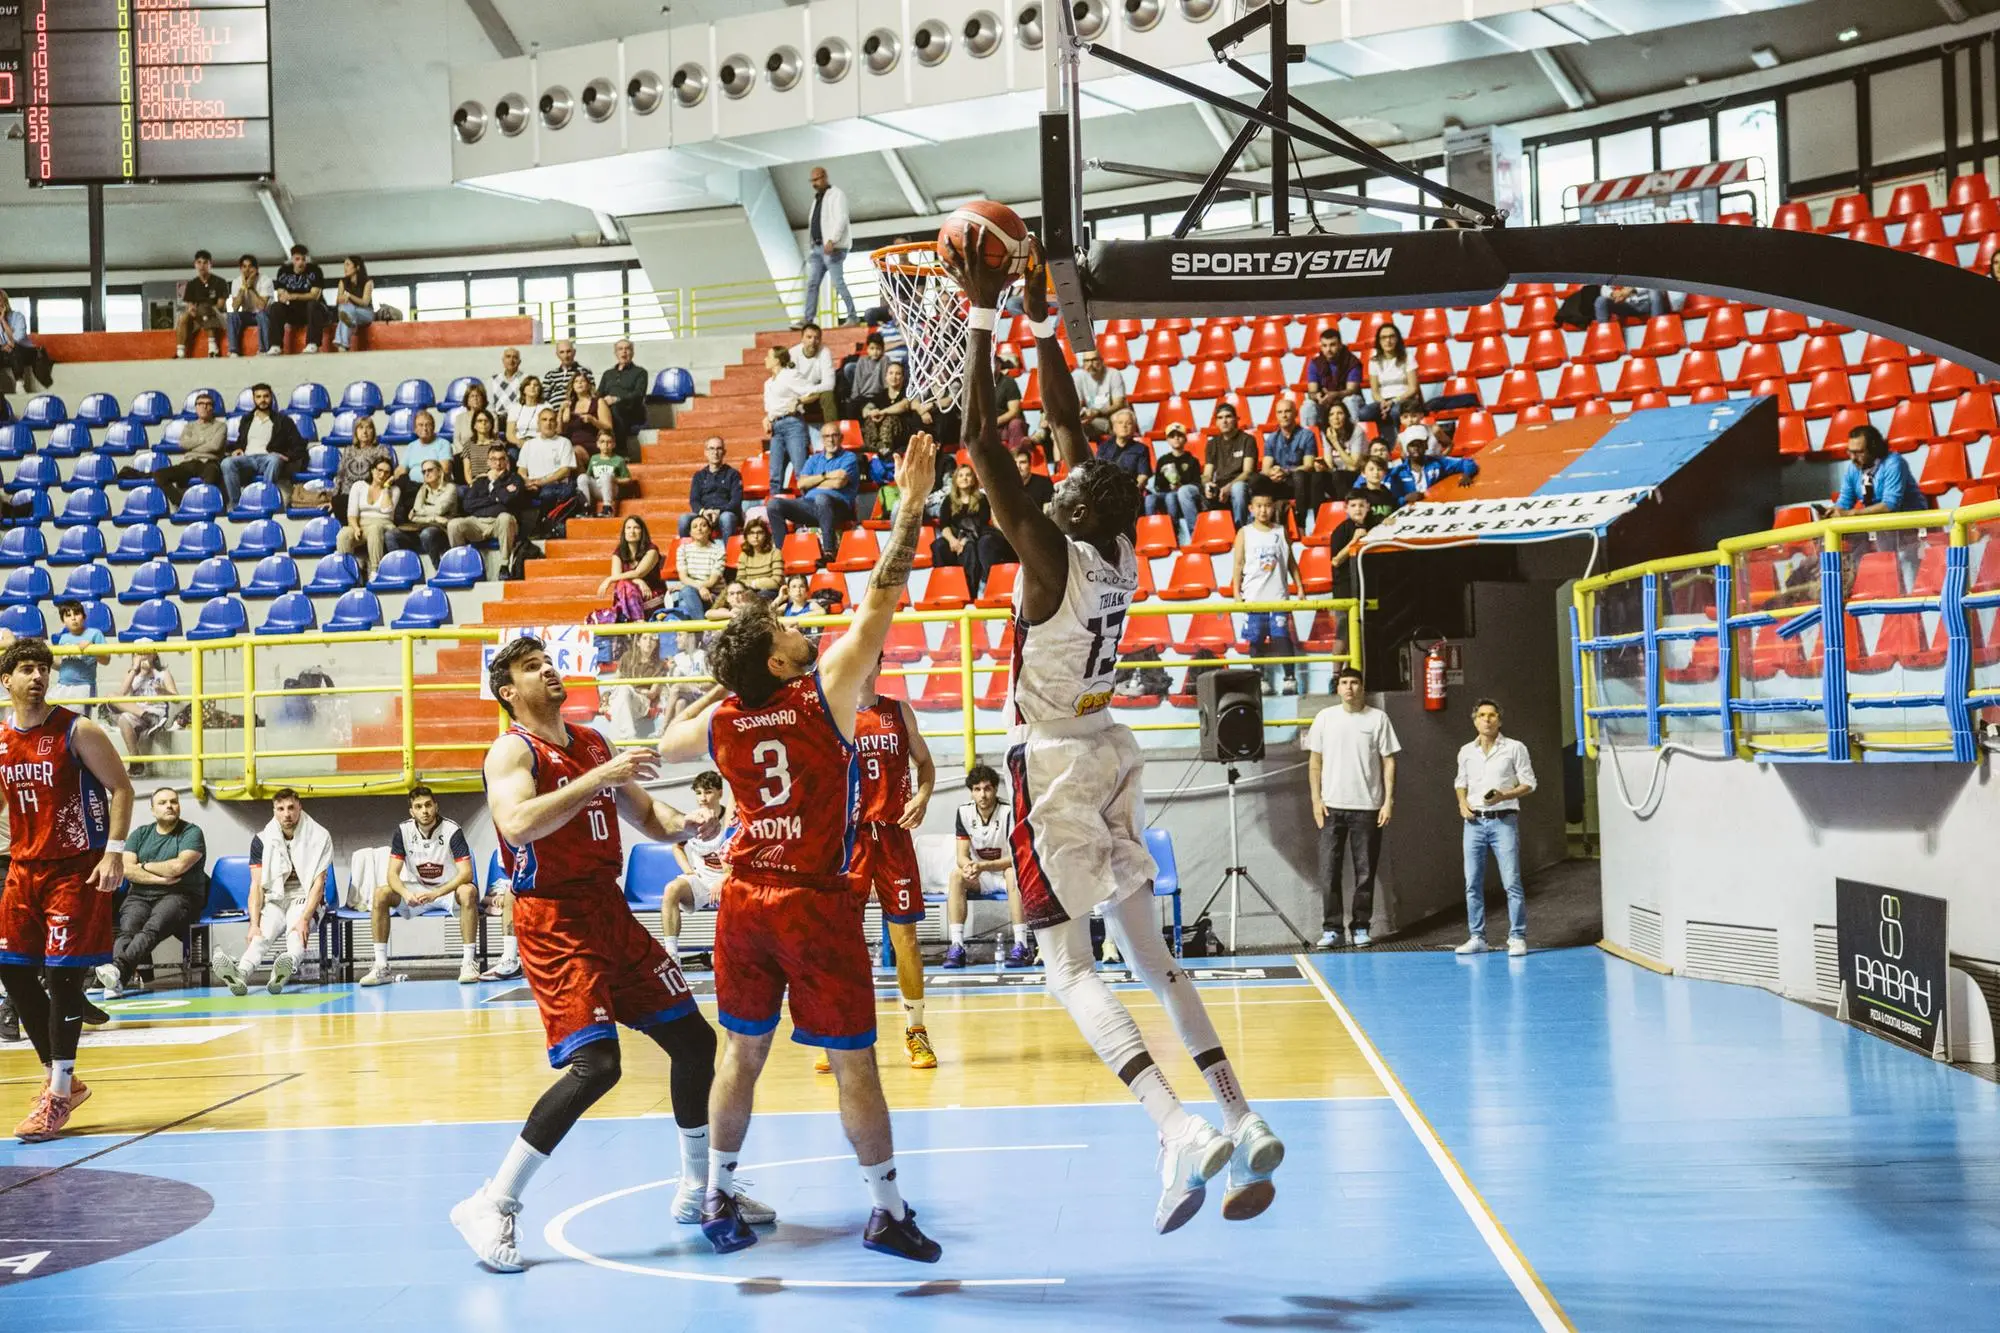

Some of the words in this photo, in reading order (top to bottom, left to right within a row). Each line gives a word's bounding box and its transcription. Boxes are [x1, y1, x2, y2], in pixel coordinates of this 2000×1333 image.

[37, 13, 46, 31] 8
[118, 11, 128, 29] 0
[37, 32, 47, 50] 9
[119, 30, 129, 48] 0
[138, 27, 231, 47] LUCARELLI
[33, 50, 48, 68] 10
[119, 48, 130, 67] 0
[138, 46, 213, 65] MARTINO
[33, 69, 48, 87] 13
[120, 67, 130, 85] 0
[139, 65, 202, 85] MAIOLO
[34, 88, 49, 104] 14
[121, 85, 131, 103] 0
[140, 83, 192, 102] GALLI
[28, 107, 49, 125] 22
[121, 104, 131, 122] 0
[140, 99, 225, 120] CONVERSO
[29, 124, 50, 143] 32
[122, 122, 132, 141] 0
[140, 119, 246, 141] COLAGROSSI
[40, 143, 50, 161] 0
[122, 141, 133, 159] 0
[41, 161, 51, 179] 0
[123, 159, 133, 177] 0
[1392, 491, 1641, 519] MARIANELLA
[1394, 512, 1595, 535] PRESENTE
[1100, 591, 1127, 610] THIAM
[732, 709, 798, 733] SCIANARO
[752, 738, 791, 808] 3
[867, 758, 880, 780] 9
[17, 789, 39, 814] 14
[587, 809, 609, 841] 10
[898, 889, 910, 910] 9
[48, 925, 68, 951] 14
[658, 967, 688, 996] 10
[1854, 953, 1932, 1017] BABAY
